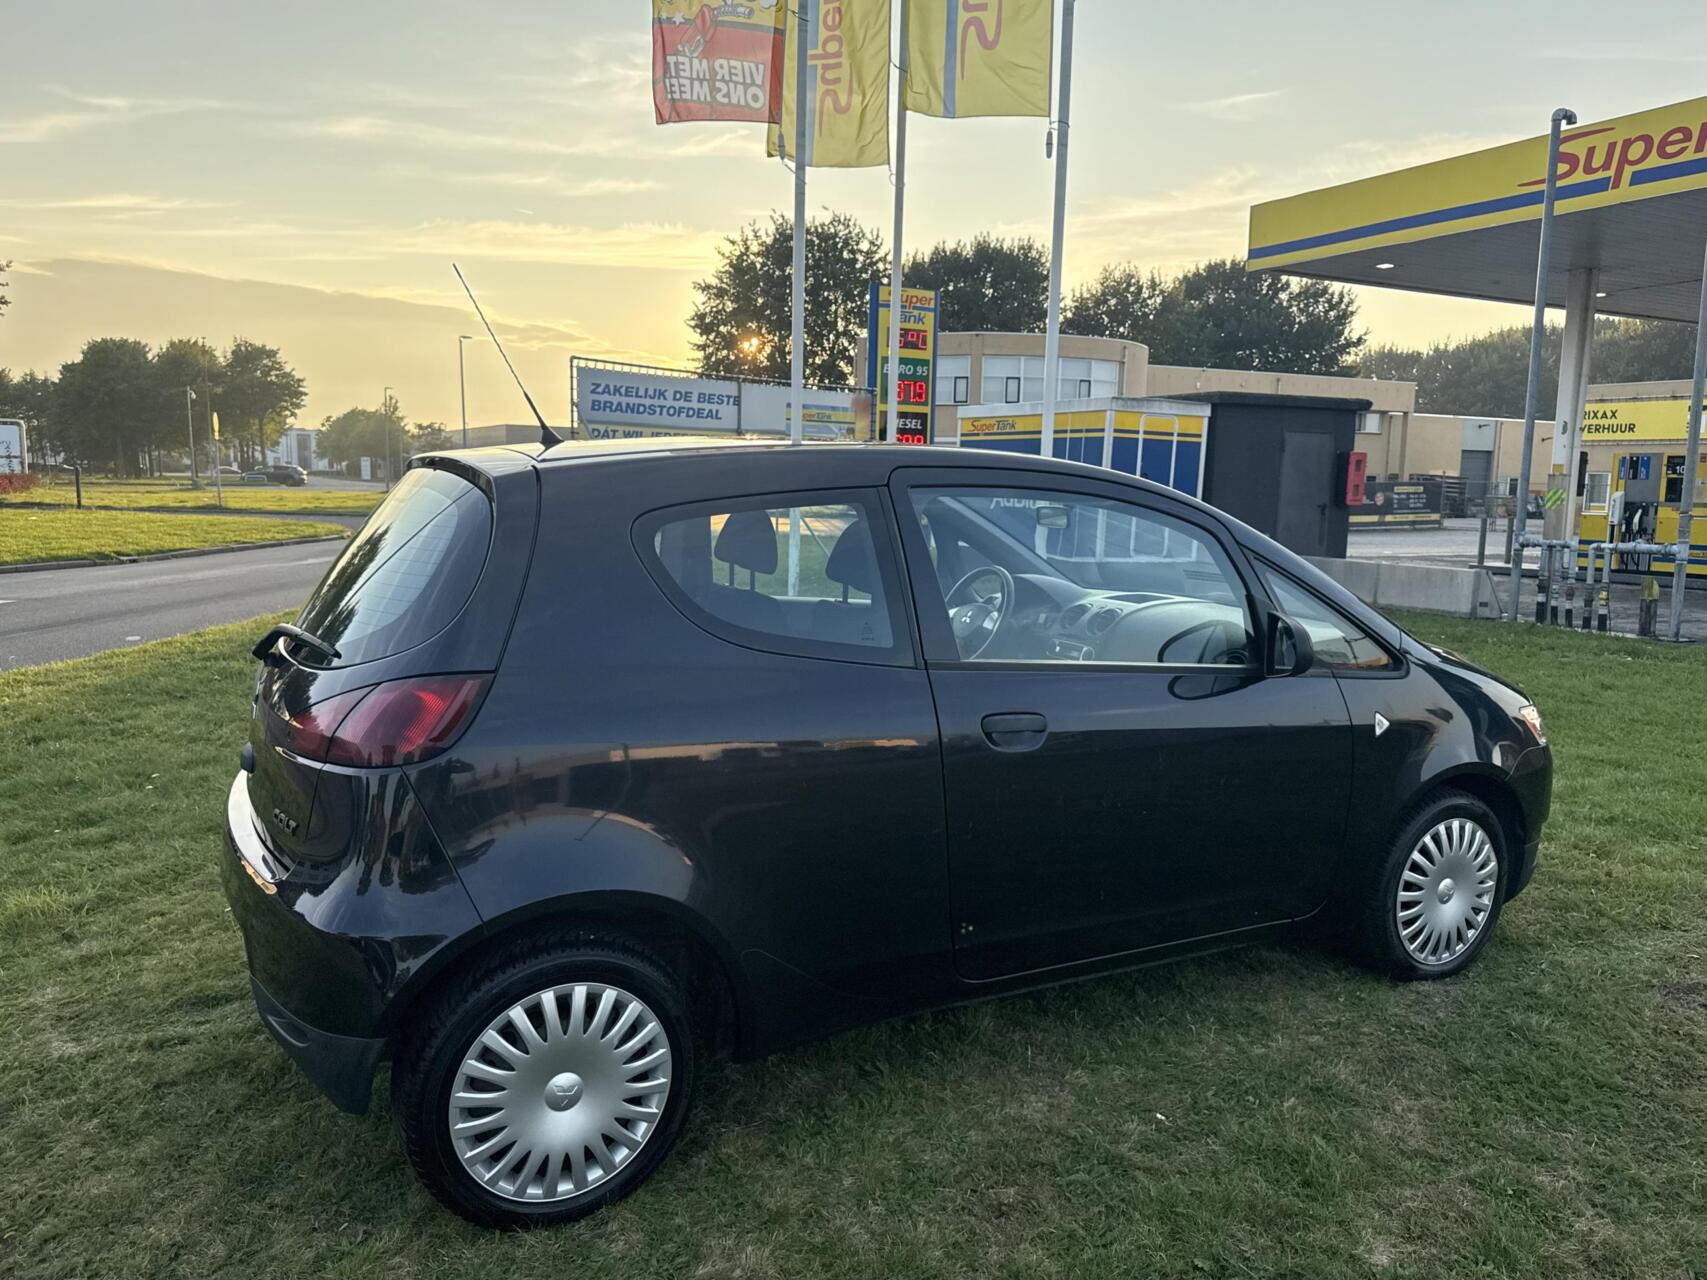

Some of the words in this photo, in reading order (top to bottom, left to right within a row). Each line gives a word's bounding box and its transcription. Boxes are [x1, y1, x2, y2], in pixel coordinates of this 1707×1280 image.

[886, 289, 934, 310] uper
[889, 311, 926, 325] ank
[883, 363, 914, 375] ERO
[916, 366, 928, 376] 95
[590, 382, 668, 401] ZAKELIJK
[673, 390, 693, 403] DE
[697, 392, 740, 406] BESTE
[590, 399, 722, 420] BRANDSTOFDEAL
